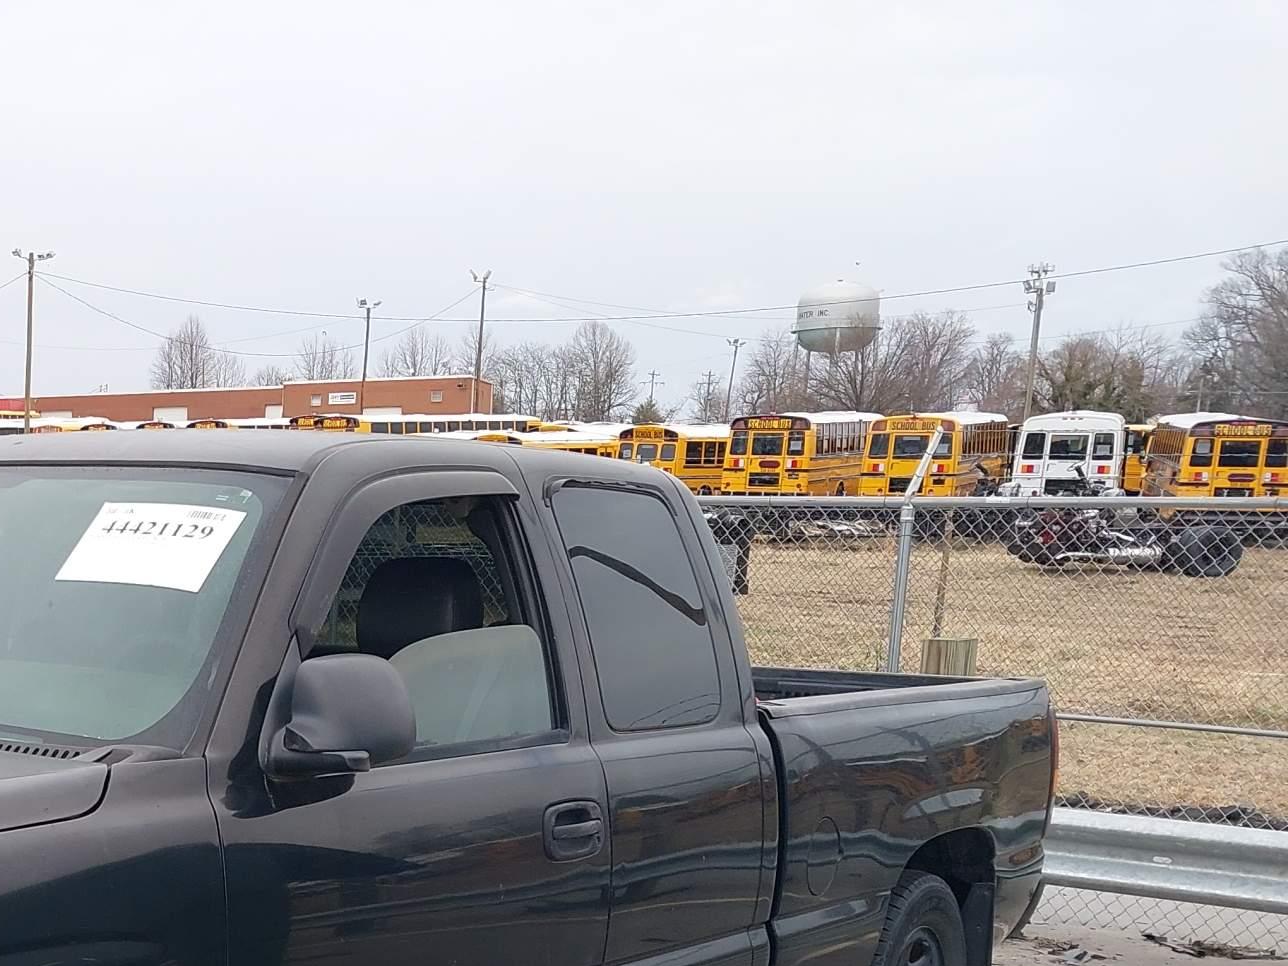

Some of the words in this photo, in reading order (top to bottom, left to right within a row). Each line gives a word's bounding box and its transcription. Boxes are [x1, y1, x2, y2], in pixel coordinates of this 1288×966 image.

[749, 419, 775, 428] SCHOOL
[891, 421, 918, 430] SCHOOL
[921, 421, 936, 430] BUS
[1215, 425, 1250, 436] SCHOOL
[1253, 425, 1272, 436] BUS
[102, 520, 214, 539] 44421129
